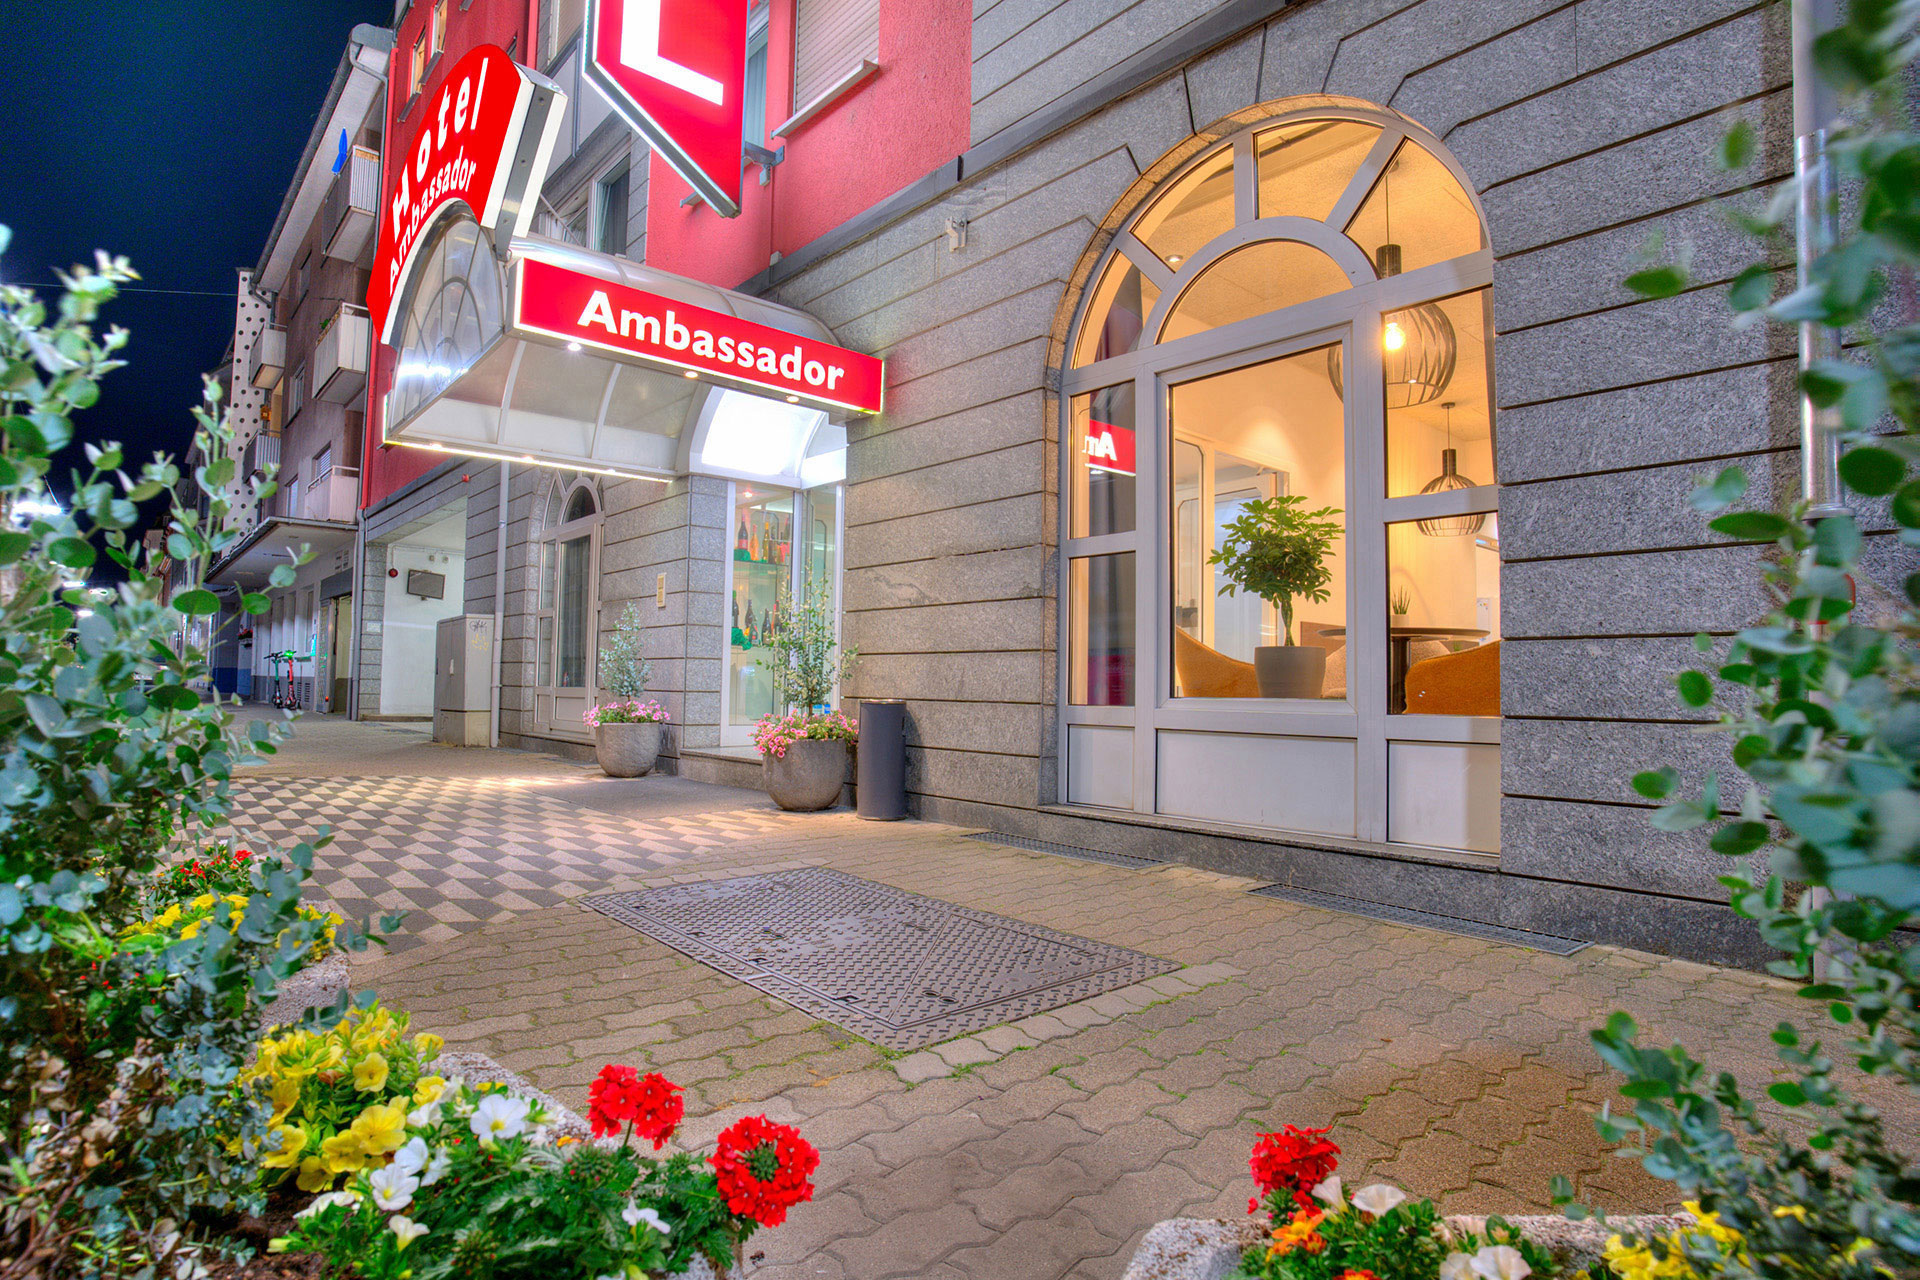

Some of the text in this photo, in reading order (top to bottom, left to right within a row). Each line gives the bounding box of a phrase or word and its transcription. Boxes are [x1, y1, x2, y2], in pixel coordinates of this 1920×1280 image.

[389, 145, 477, 297] Ambassador
[392, 57, 489, 243] Hotel
[577, 290, 845, 390] Ambassador
